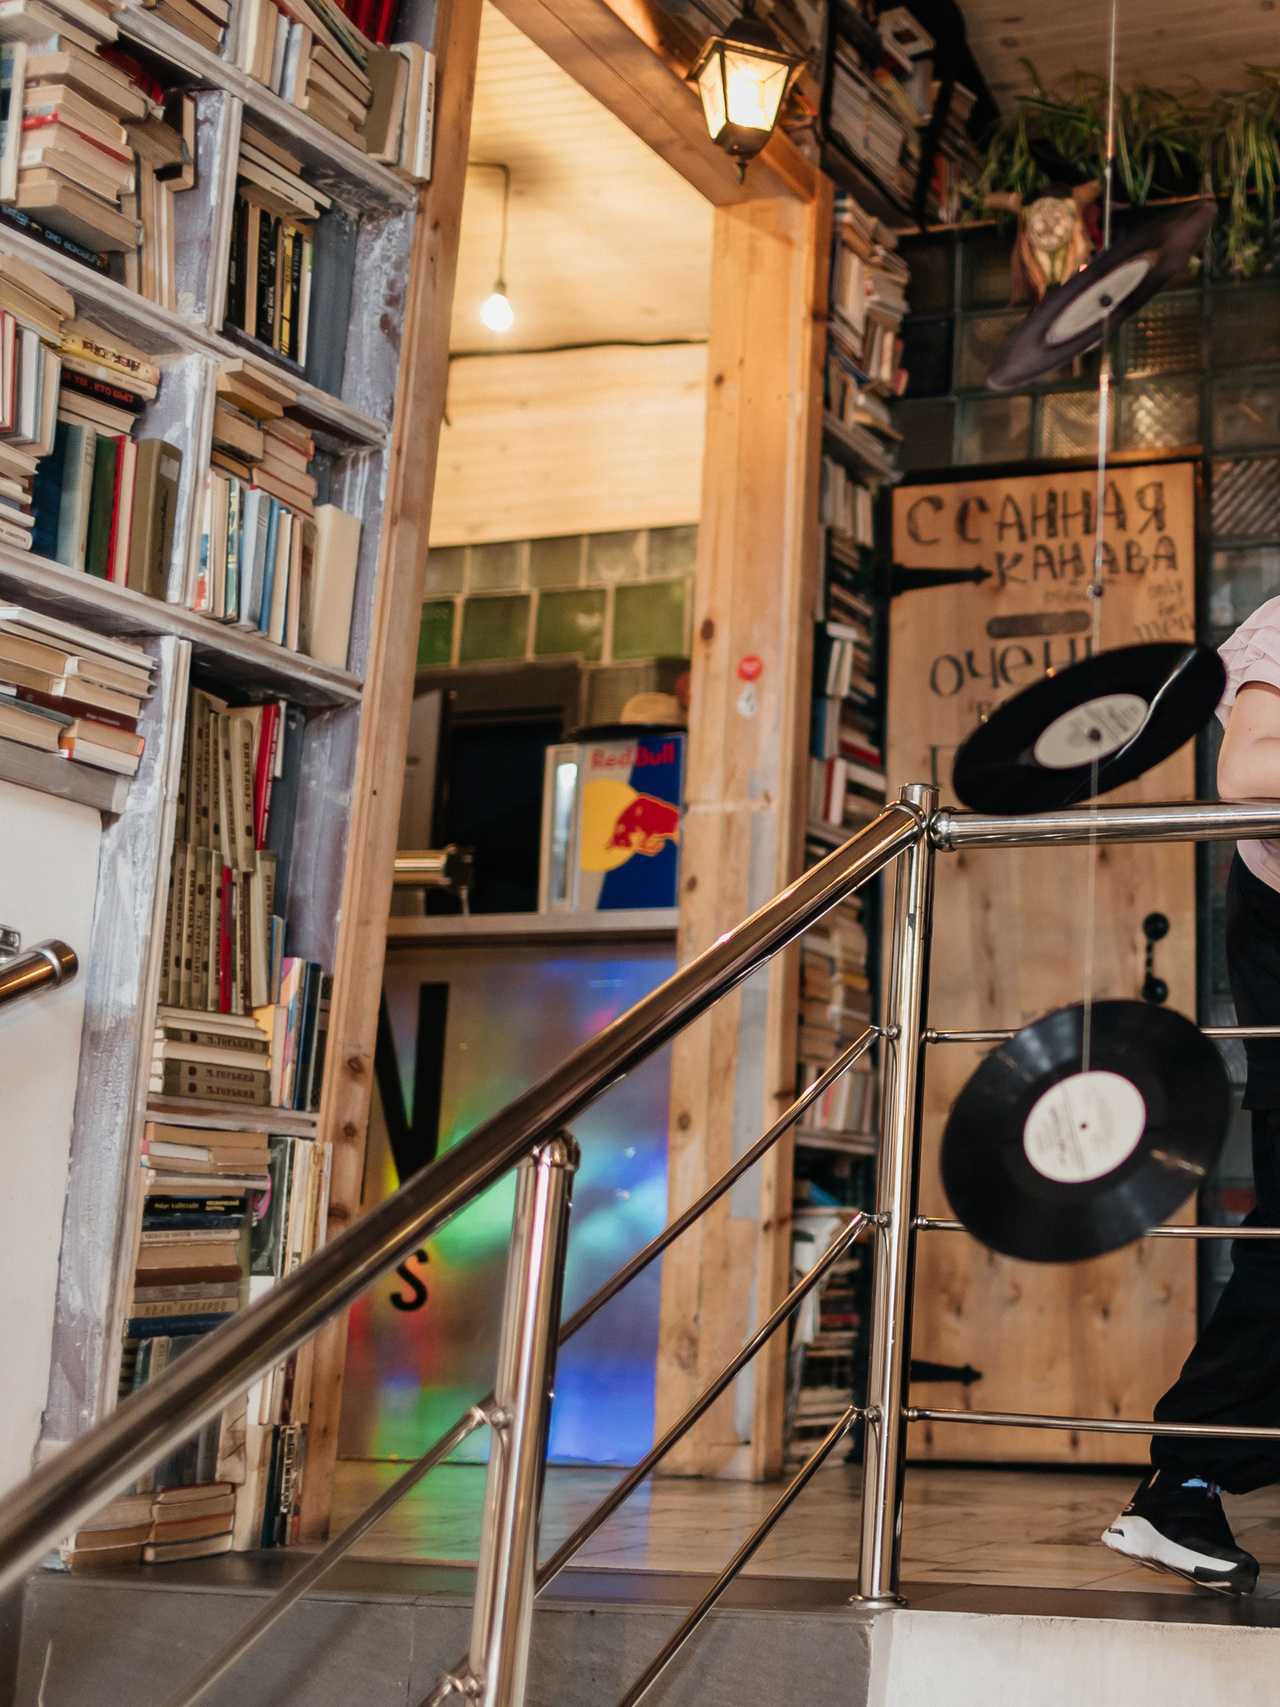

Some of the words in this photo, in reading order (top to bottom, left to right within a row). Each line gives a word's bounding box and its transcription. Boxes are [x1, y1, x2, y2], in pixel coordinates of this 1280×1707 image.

[906, 481, 1166, 546] ССАННАЯ
[994, 535, 1179, 588] КАНАВА
[591, 747, 633, 770] Red
[635, 741, 675, 768] Bull
